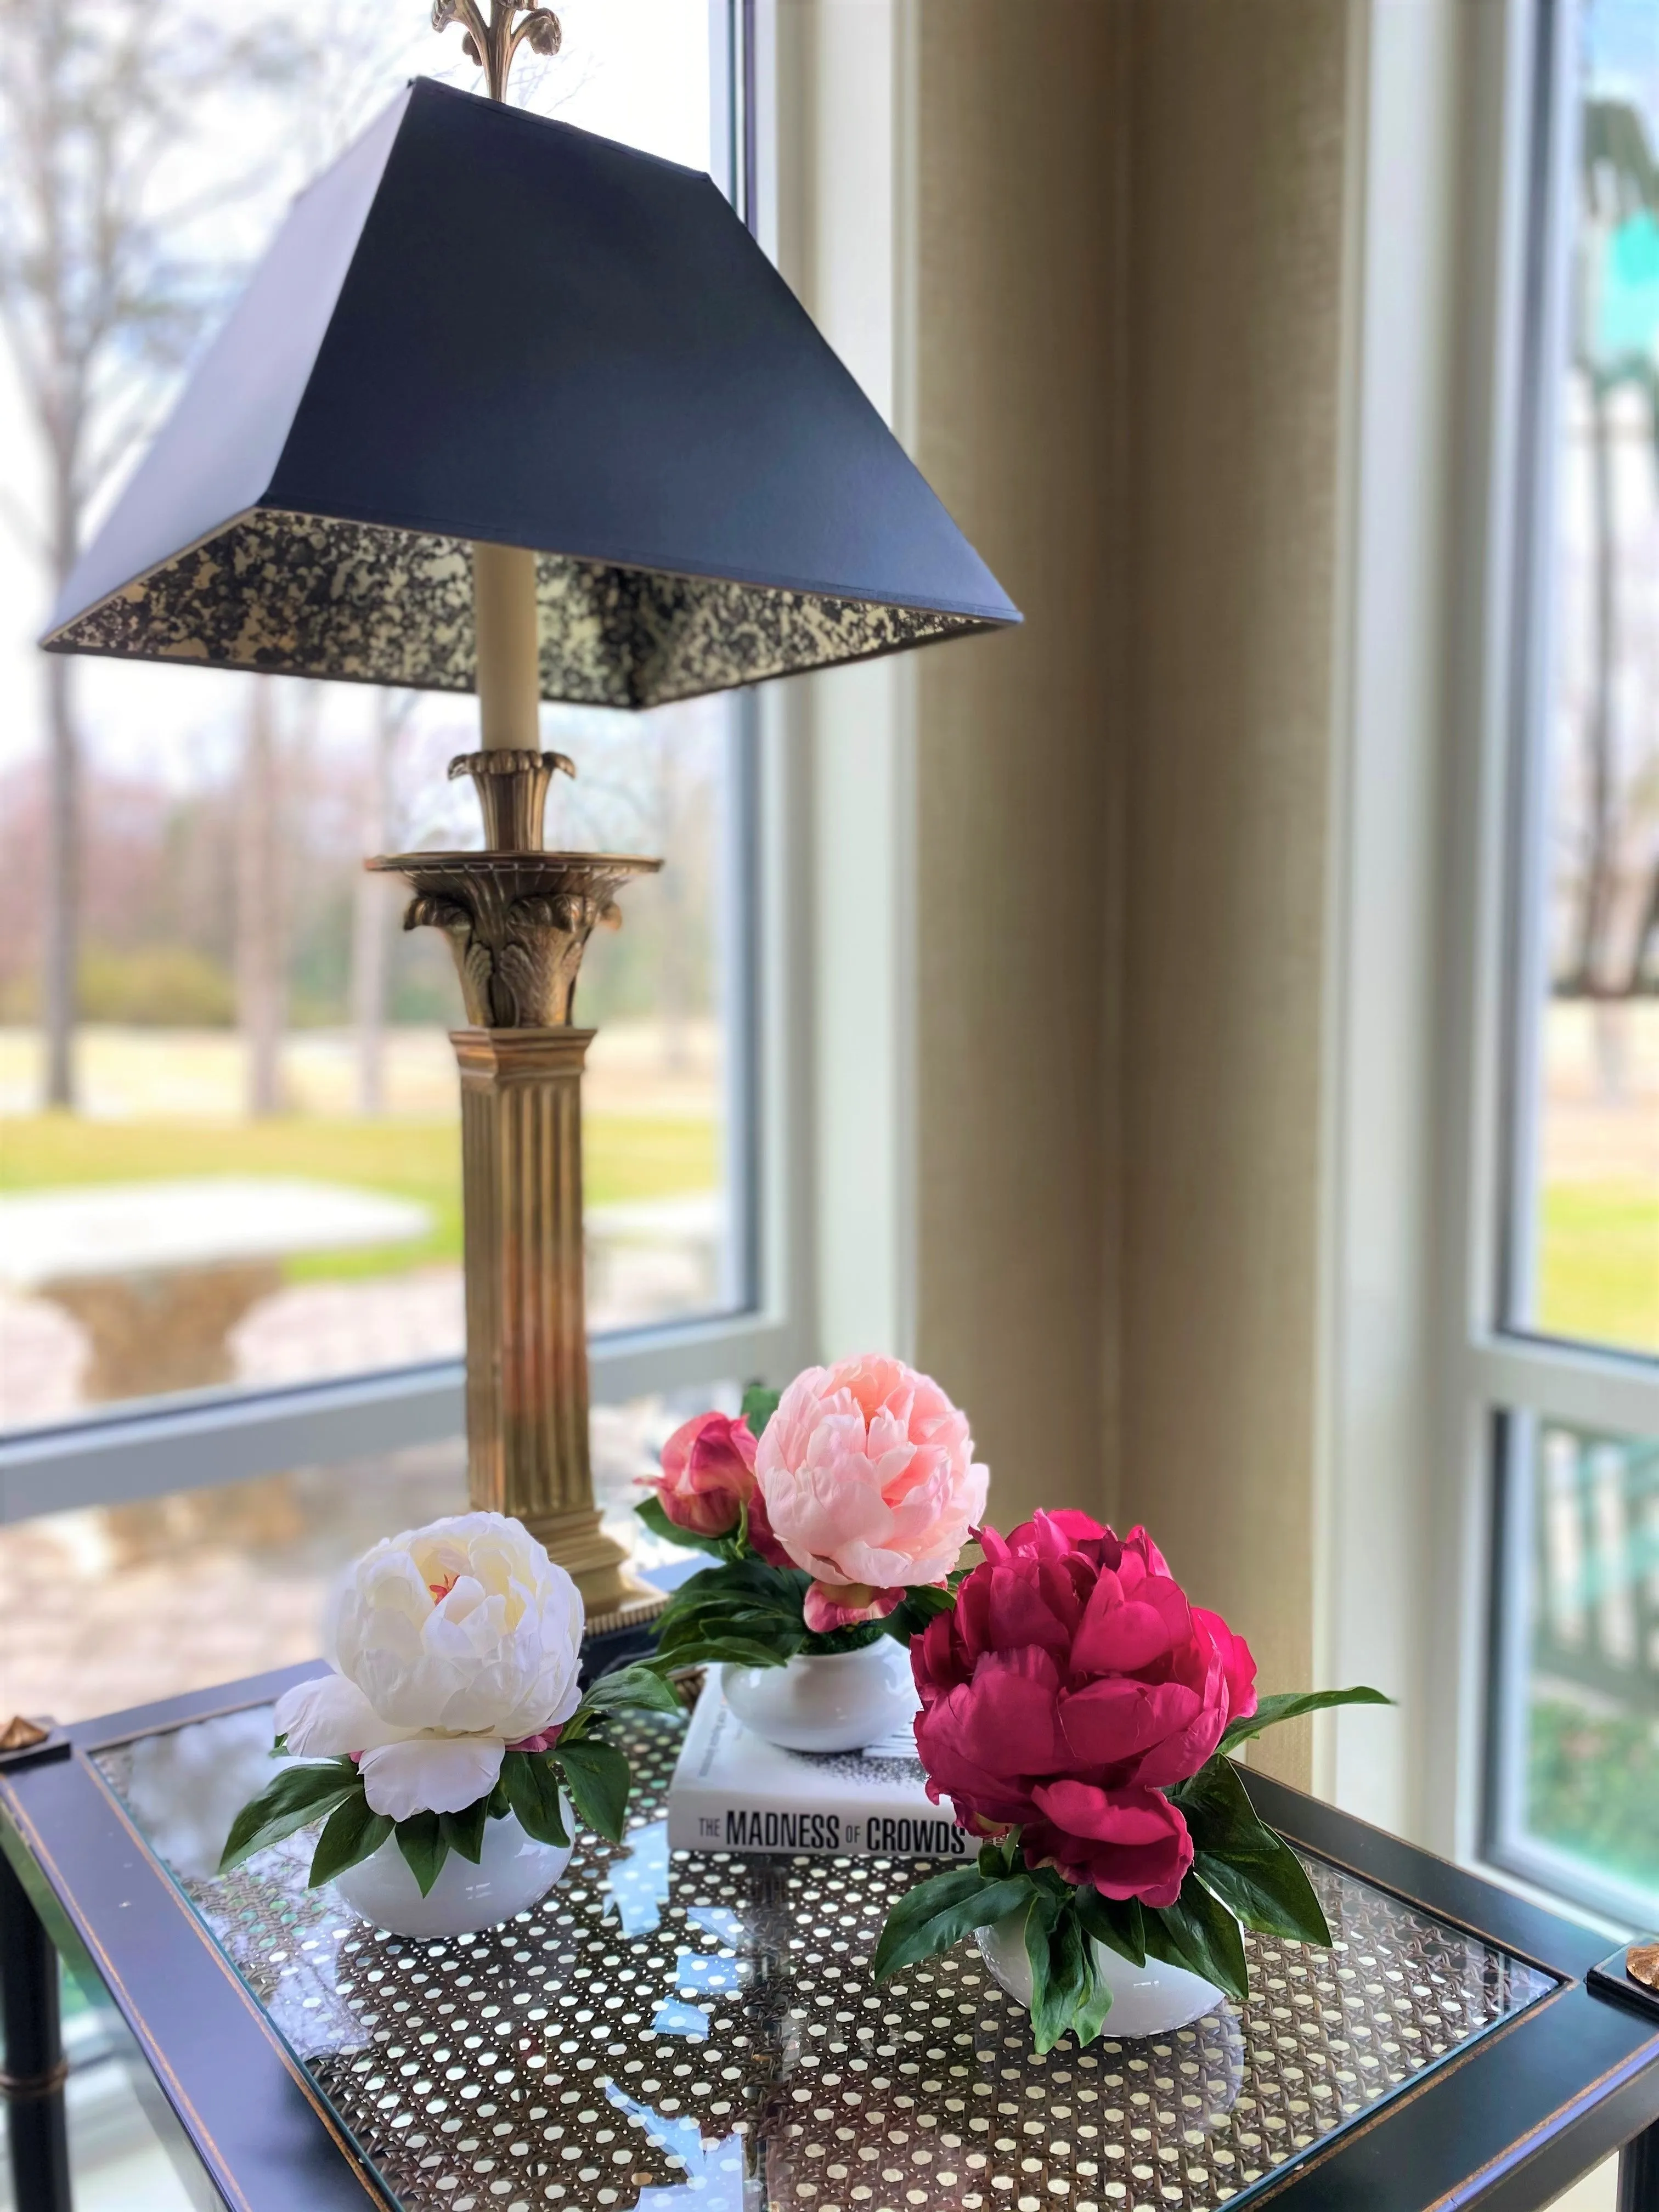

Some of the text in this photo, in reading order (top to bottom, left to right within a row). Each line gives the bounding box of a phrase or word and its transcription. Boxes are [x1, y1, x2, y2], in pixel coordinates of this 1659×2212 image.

[699, 1818, 720, 1836] THE
[726, 1810, 839, 1849] MADNESS
[845, 1825, 861, 1843] OF
[867, 1816, 965, 1854] CROWDS
